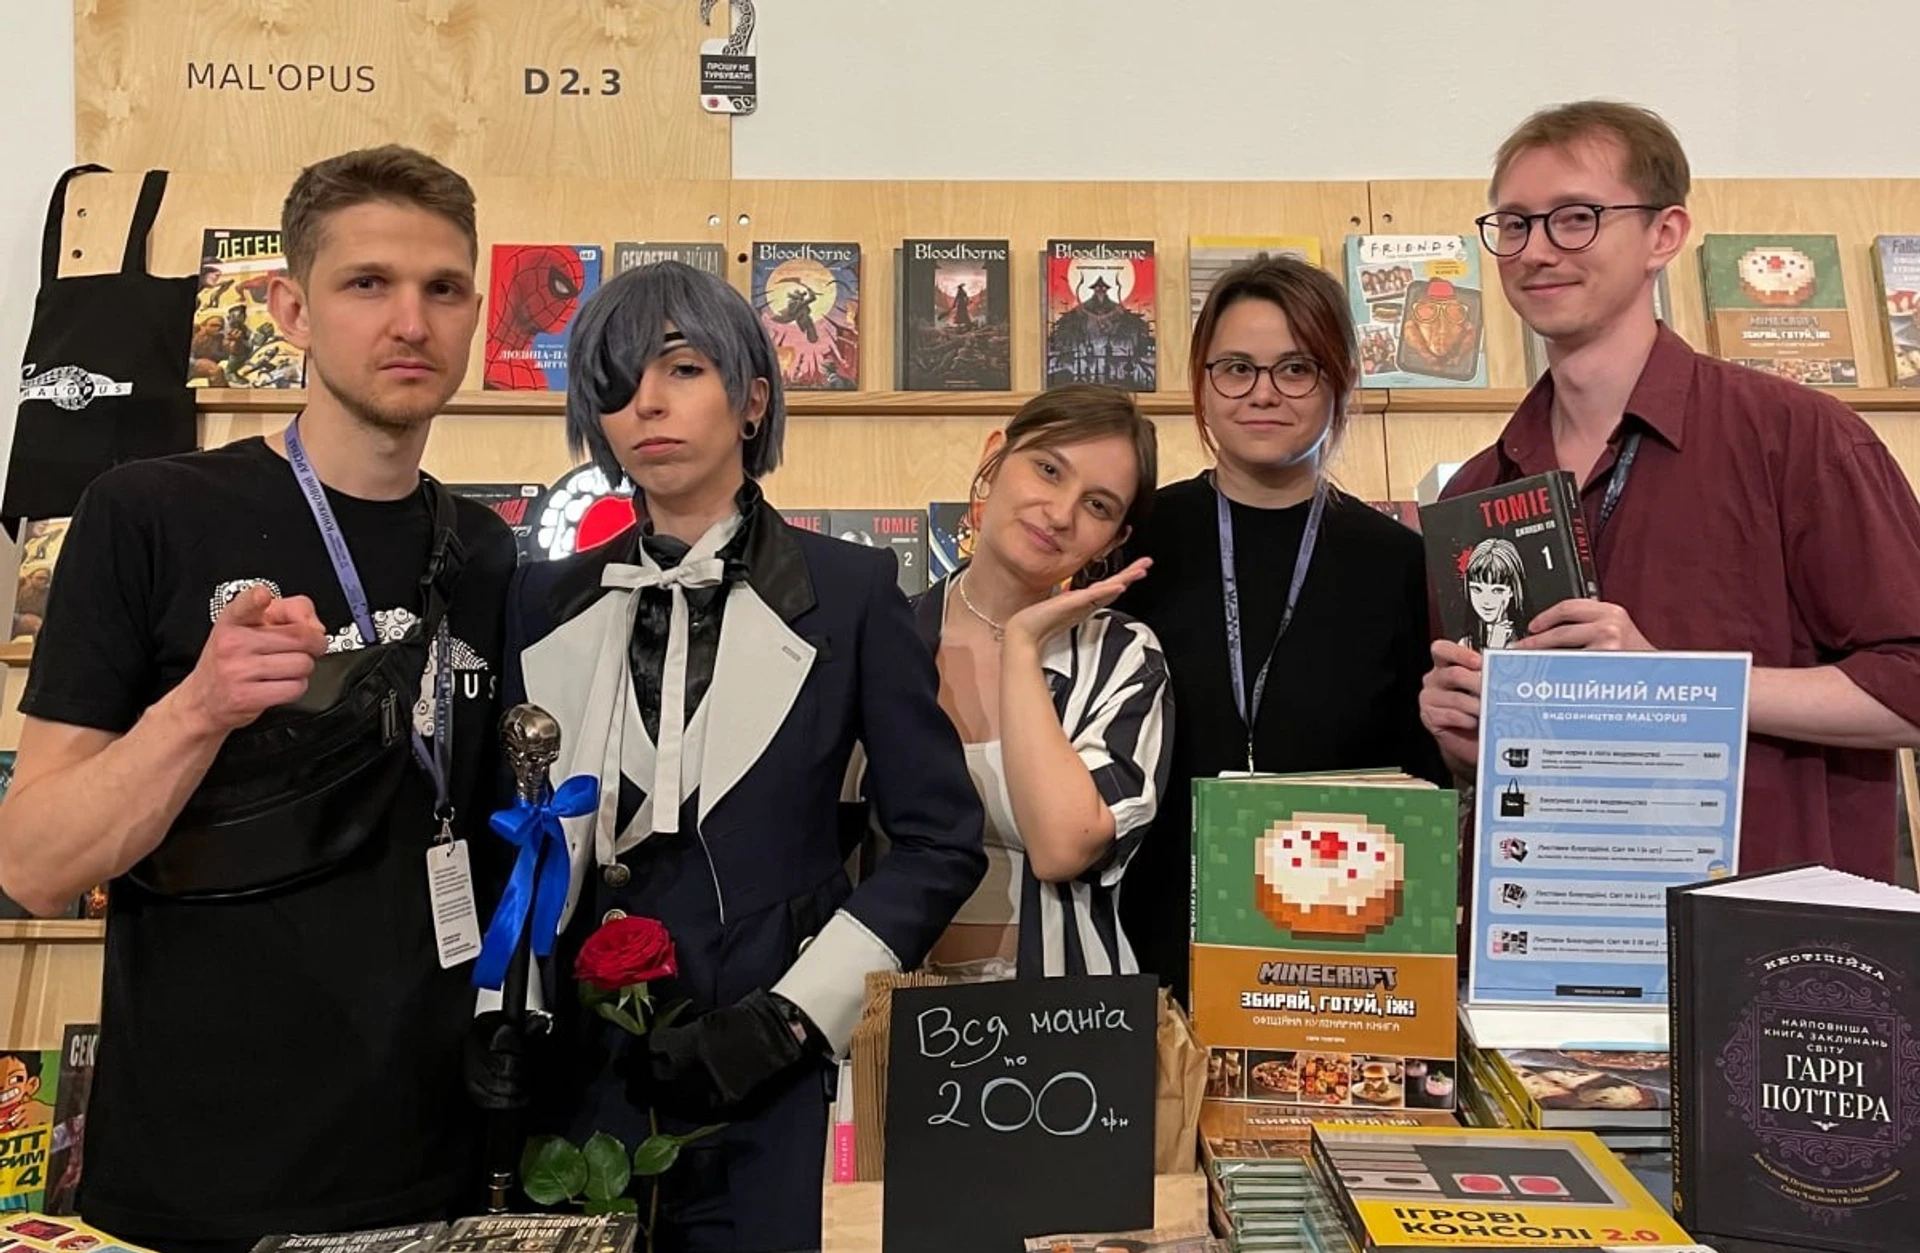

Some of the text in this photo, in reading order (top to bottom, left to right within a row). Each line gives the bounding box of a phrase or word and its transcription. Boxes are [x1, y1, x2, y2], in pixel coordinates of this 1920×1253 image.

[187, 62, 375, 93] MAL'OPUS
[524, 67, 550, 95] D
[760, 243, 853, 261] Bloodborne
[914, 243, 1007, 260] Bloodborne
[1055, 243, 1147, 260] Bloodborne
[1480, 487, 1552, 529] TOMIE
[872, 516, 919, 535] TOMIE
[904, 551, 913, 567] 2
[1541, 545, 1554, 571] 1
[1517, 680, 1718, 702] ОФІЦІЙНИЙ МЕРЧ
[1625, 713, 1688, 723] MAL'OPUS
[1258, 962, 1398, 991] MINECRAFT
[1763, 953, 1885, 981] НЕОФІЦІЙНА
[1241, 989, 1417, 1018] ЗБИРАЙ, ГОТУЙ, ЇЖ!
[1782, 1018, 1869, 1034] НАЙПОВНІША
[916, 1006, 1010, 1069] Вся
[1764, 1028, 1888, 1048] КНИГА ЗАКЛИНАНЬ
[1807, 1043, 1844, 1054] СВІТУ
[1004, 1053, 1028, 1068] по
[1786, 1054, 1865, 1088] ГАРРІ
[927, 1071, 1129, 1136] 200 грн
[1762, 1083, 1893, 1123] ПОТТЕРА
[16, 1165, 42, 1187] 4
[1393, 1207, 1527, 1224] ІГРОВІ
[1402, 1221, 1592, 1240] КОНСОЛІ
[1601, 1228, 1660, 1242] 2.0
